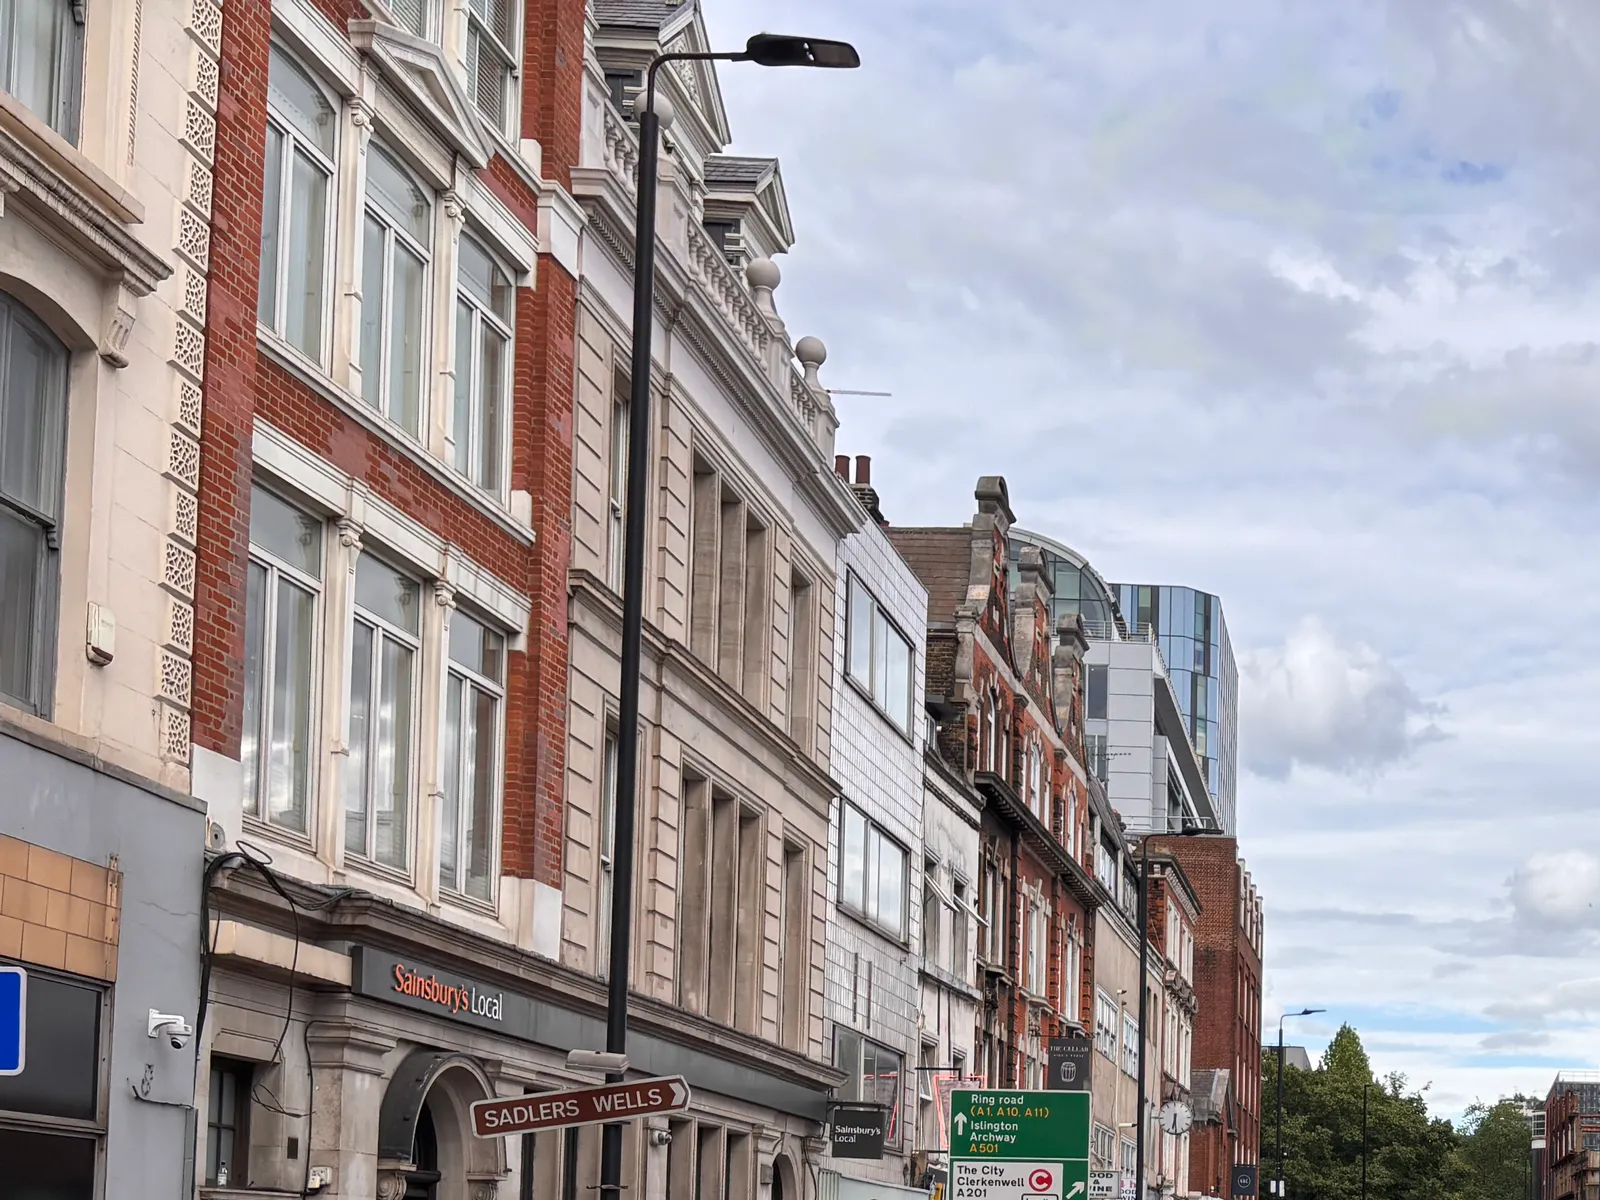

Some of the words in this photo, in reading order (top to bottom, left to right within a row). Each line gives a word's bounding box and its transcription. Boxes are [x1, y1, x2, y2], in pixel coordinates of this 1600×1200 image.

[394, 964, 469, 1015] Sainsbury's
[471, 987, 503, 1021] Local
[971, 1094, 995, 1106] Ring
[999, 1095, 1024, 1105] road
[484, 1099, 580, 1128] SADLERS
[592, 1088, 662, 1114] WELLS
[835, 1125, 881, 1137] Sainsbury's
[970, 1120, 1019, 1132] Islington
[834, 1134, 856, 1143] Local
[969, 1132, 1016, 1143] Archway
[969, 1143, 999, 1153] A501
[957, 1165, 977, 1175] The
[981, 1165, 1005, 1177] City
[957, 1176, 1025, 1187] Clerkenwell
[957, 1188, 987, 1198] A201
